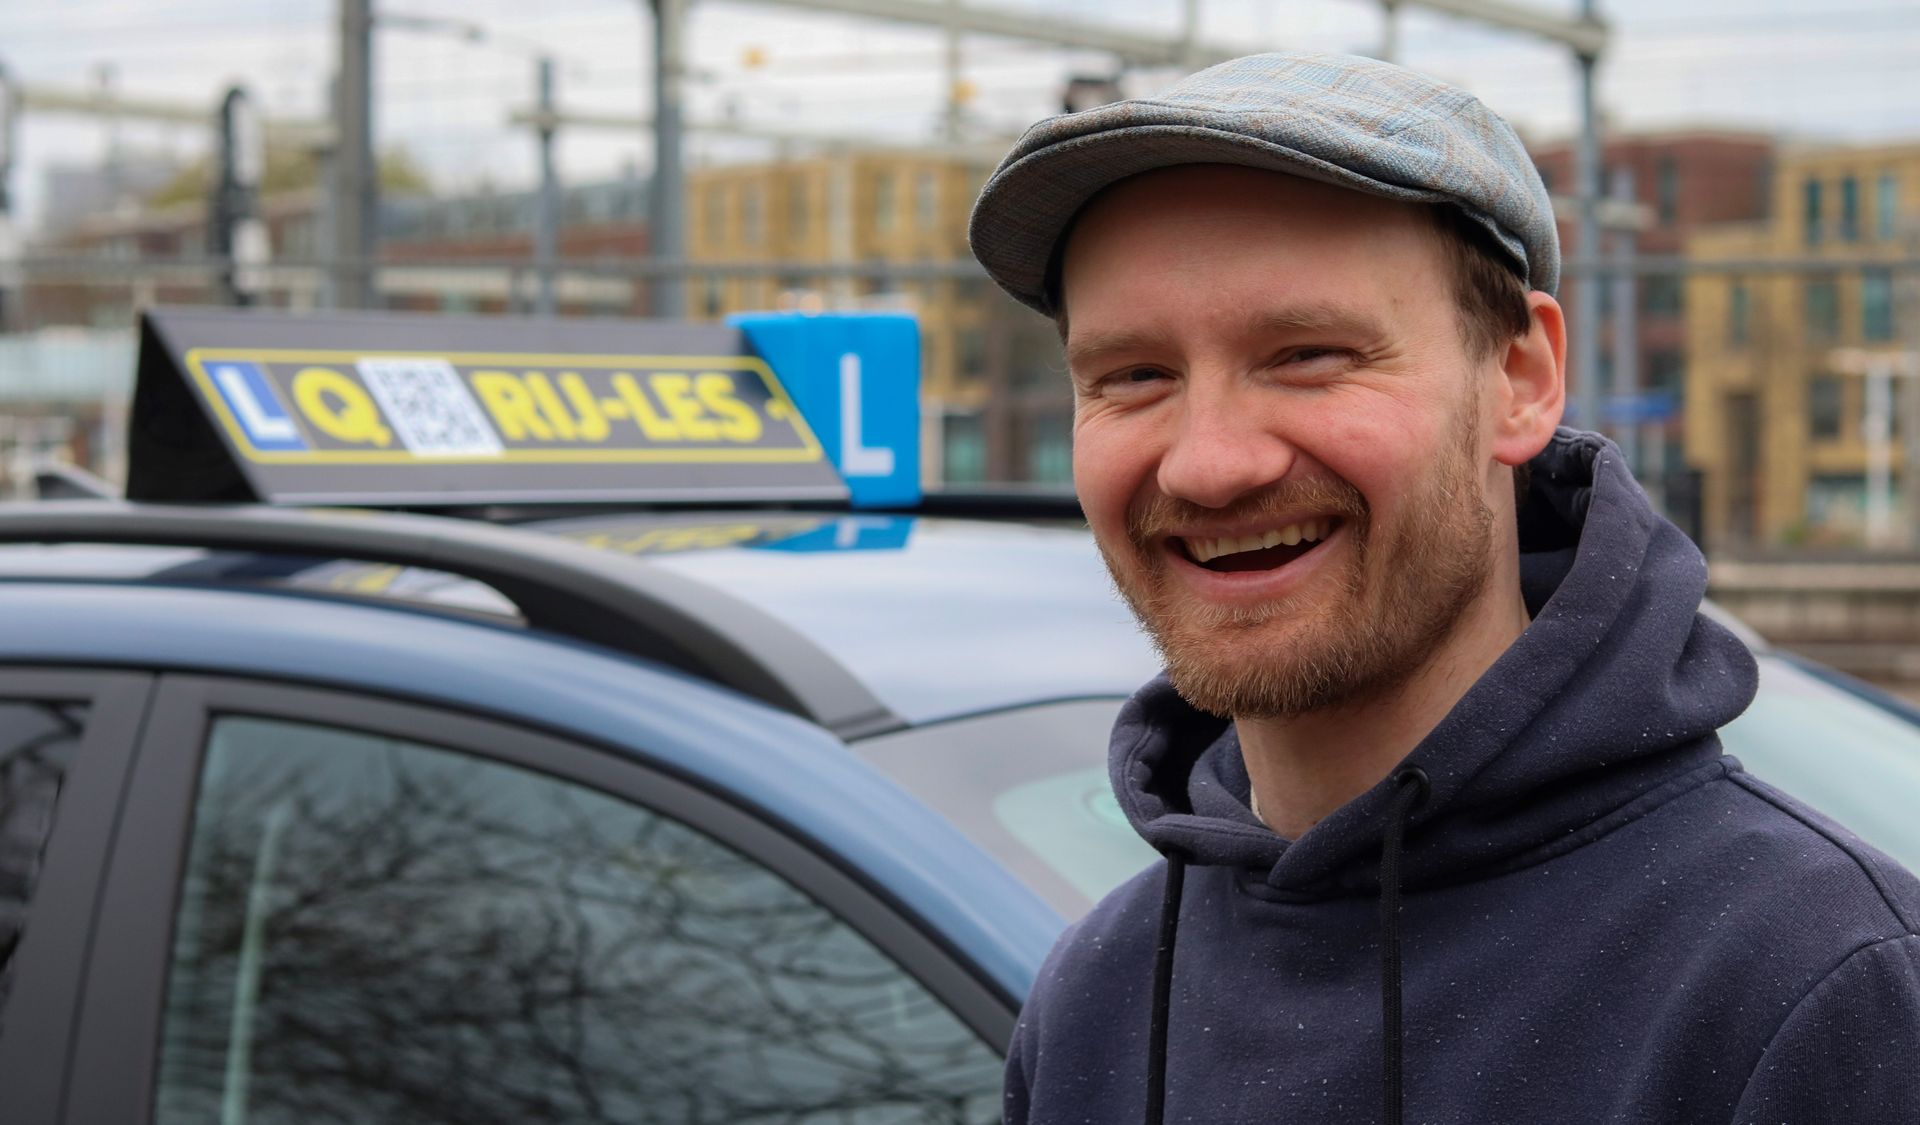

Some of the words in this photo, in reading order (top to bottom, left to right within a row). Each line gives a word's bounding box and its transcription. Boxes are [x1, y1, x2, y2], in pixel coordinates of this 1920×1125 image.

[215, 365, 297, 441] L
[292, 367, 391, 447] Q
[839, 352, 895, 477] L
